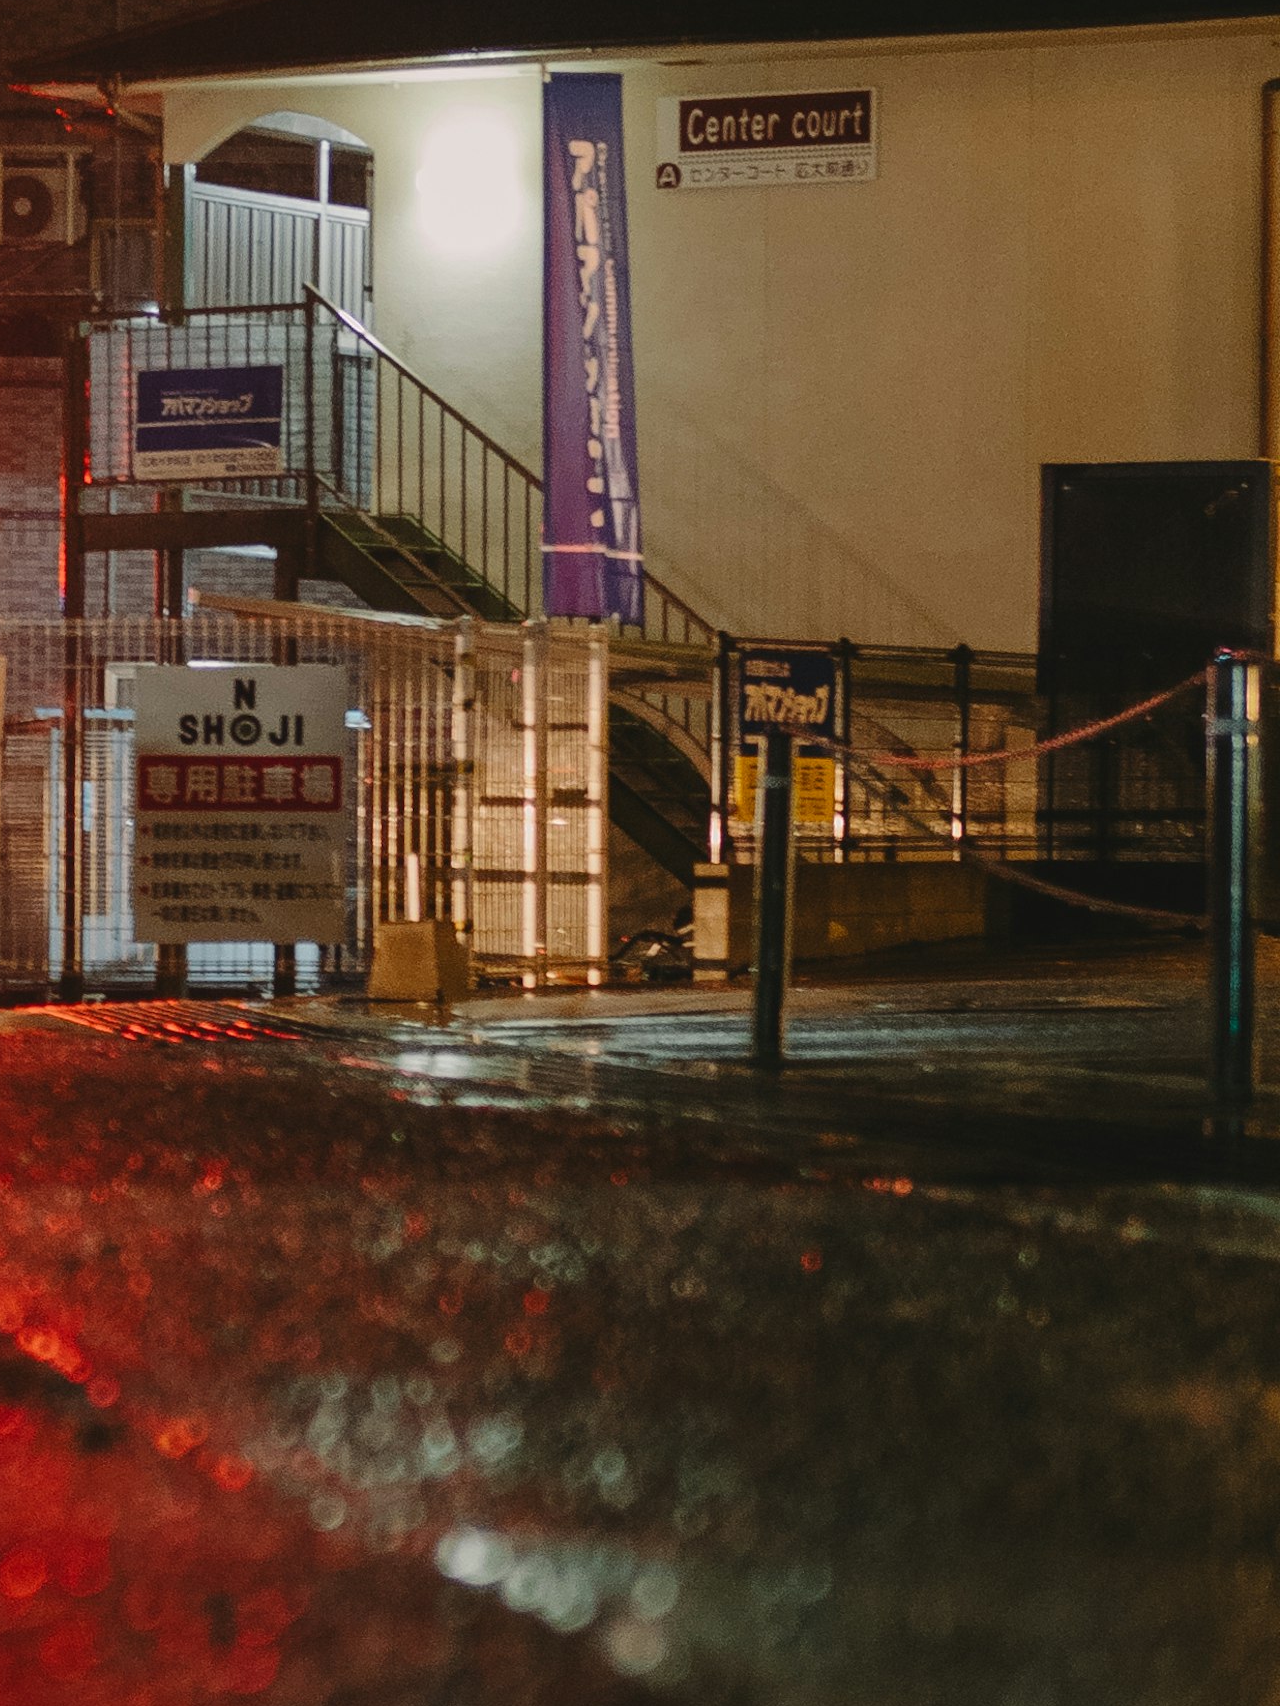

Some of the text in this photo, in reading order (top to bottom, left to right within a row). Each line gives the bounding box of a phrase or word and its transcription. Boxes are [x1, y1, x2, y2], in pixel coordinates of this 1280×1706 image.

[686, 102, 864, 145] Center court
[689, 164, 786, 183] センターコート
[233, 678, 257, 710] N
[179, 714, 305, 746] SHOJI
[145, 763, 335, 805] 専用駐車場
